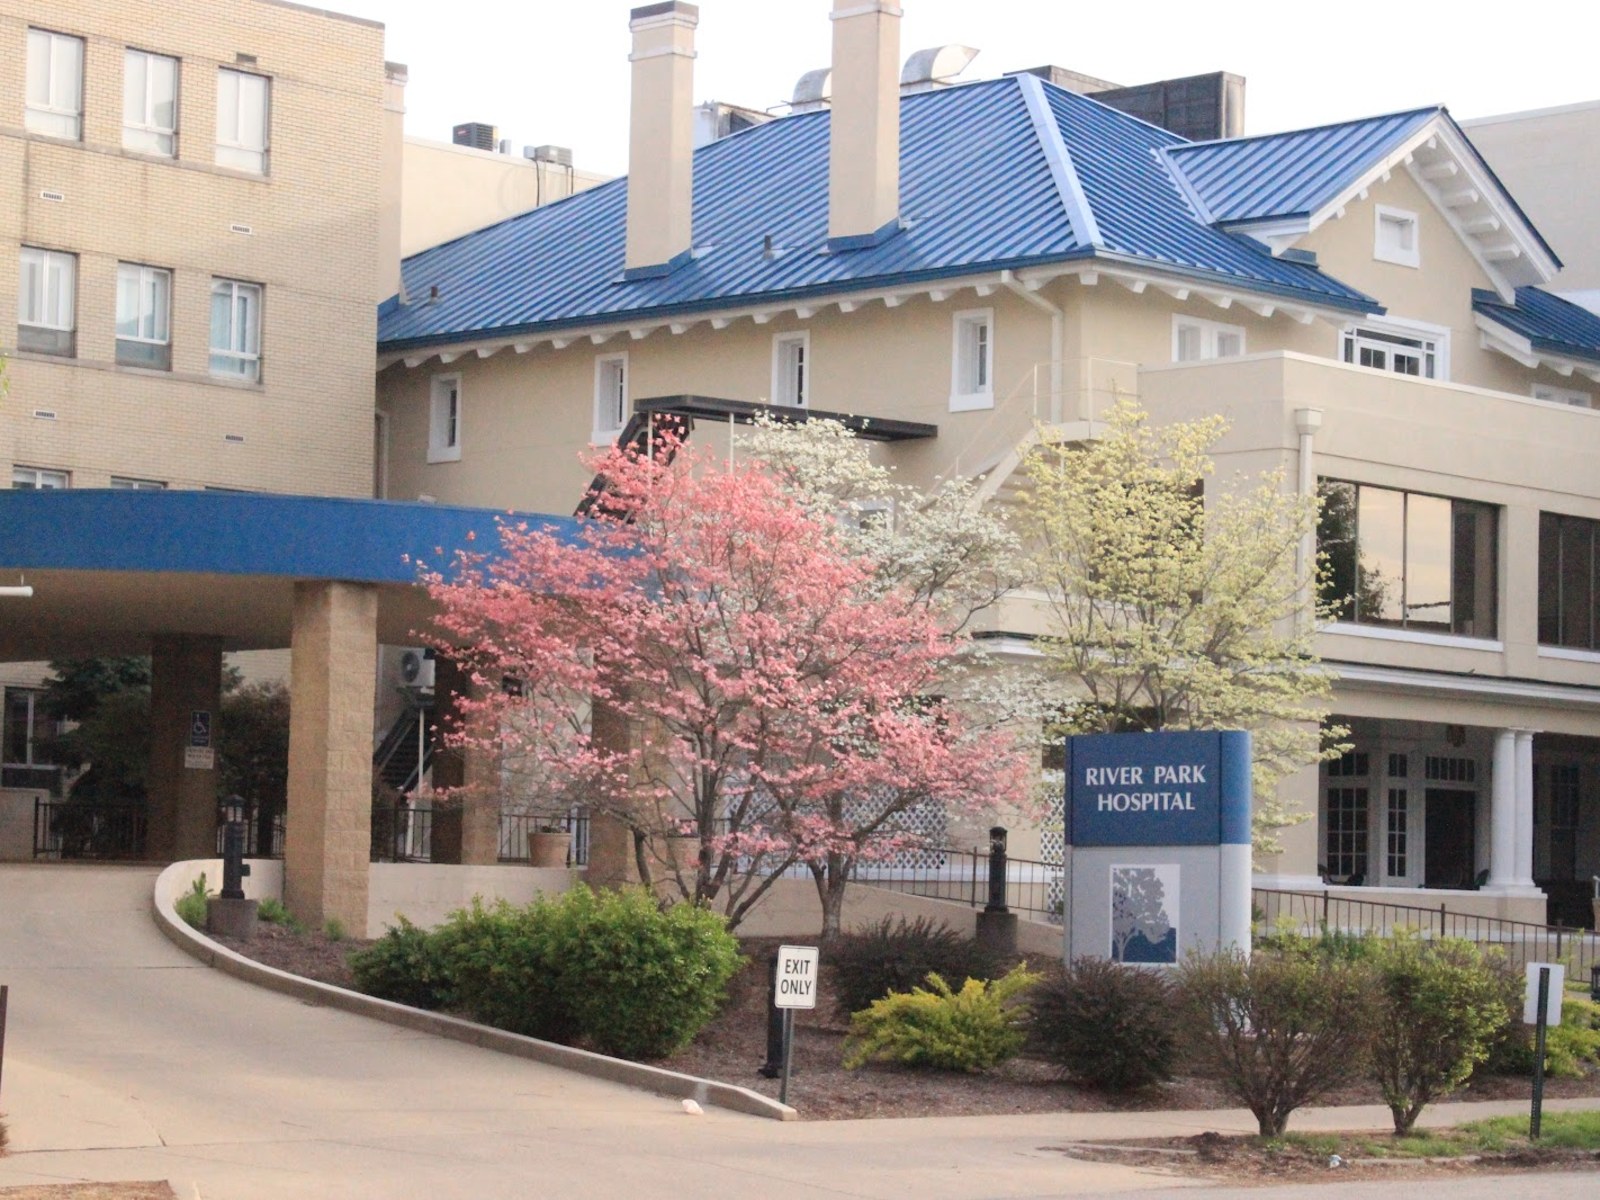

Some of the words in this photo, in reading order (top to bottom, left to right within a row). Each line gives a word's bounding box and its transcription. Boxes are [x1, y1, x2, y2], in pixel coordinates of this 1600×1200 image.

[1086, 767, 1143, 785] RIVER
[1154, 765, 1206, 784] PARK
[1098, 792, 1196, 811] HOSPITAL
[785, 959, 810, 975] EXIT
[781, 979, 812, 995] ONLY
